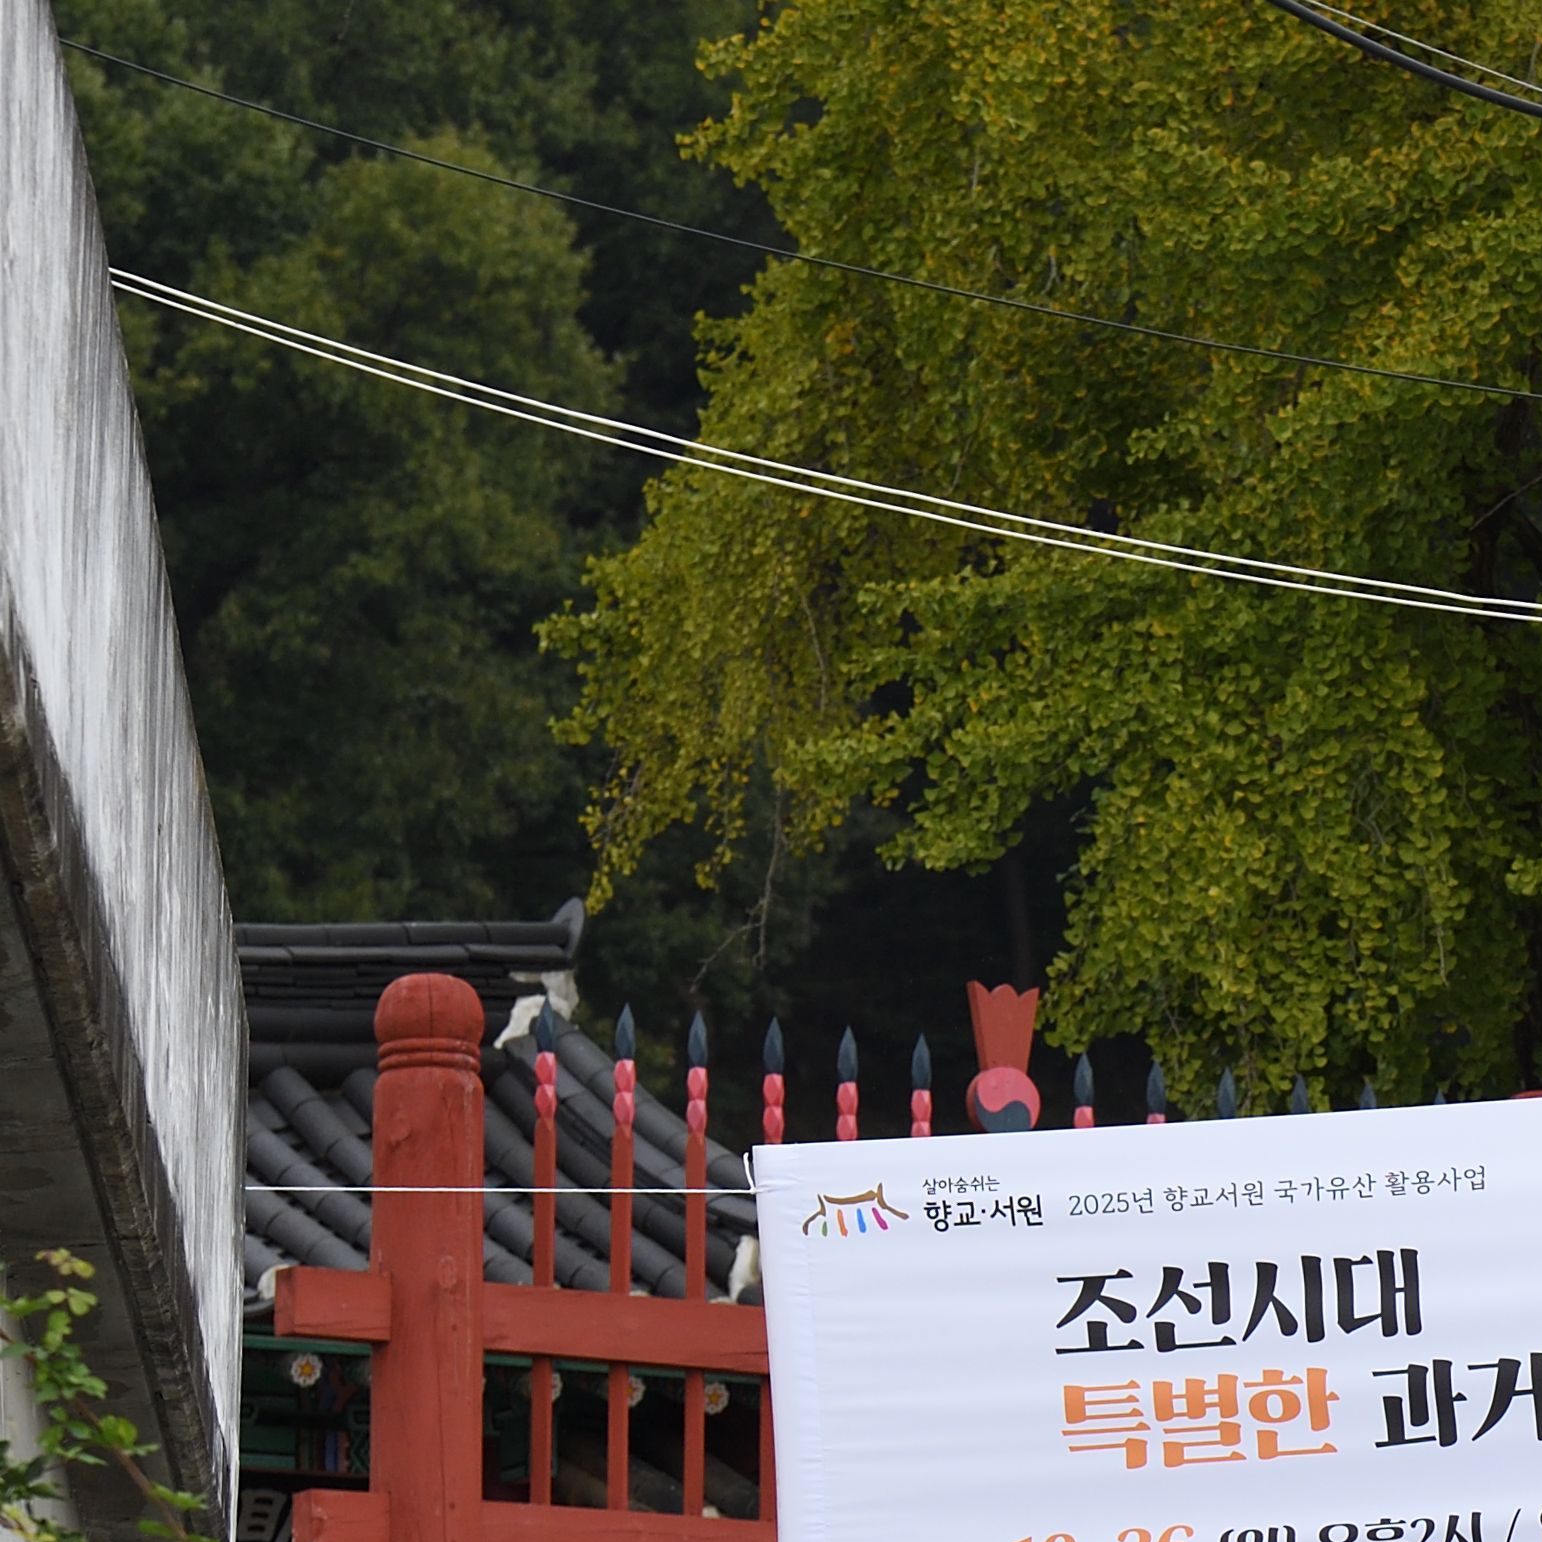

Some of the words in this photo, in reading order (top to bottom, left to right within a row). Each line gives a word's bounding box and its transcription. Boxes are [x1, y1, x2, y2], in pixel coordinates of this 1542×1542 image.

[922, 1175, 1001, 1194] 살아숨쉬는
[1069, 1188, 1153, 1216] 2025년
[1163, 1181, 1263, 1211] 향교서원
[1274, 1173, 1376, 1203] 국가유산
[1385, 1165, 1484, 1196] 활용사업
[924, 1194, 1043, 1232] 향교·서원
[1055, 1248, 1422, 1355] 조선시대
[1062, 1368, 1339, 1469] 특별한
